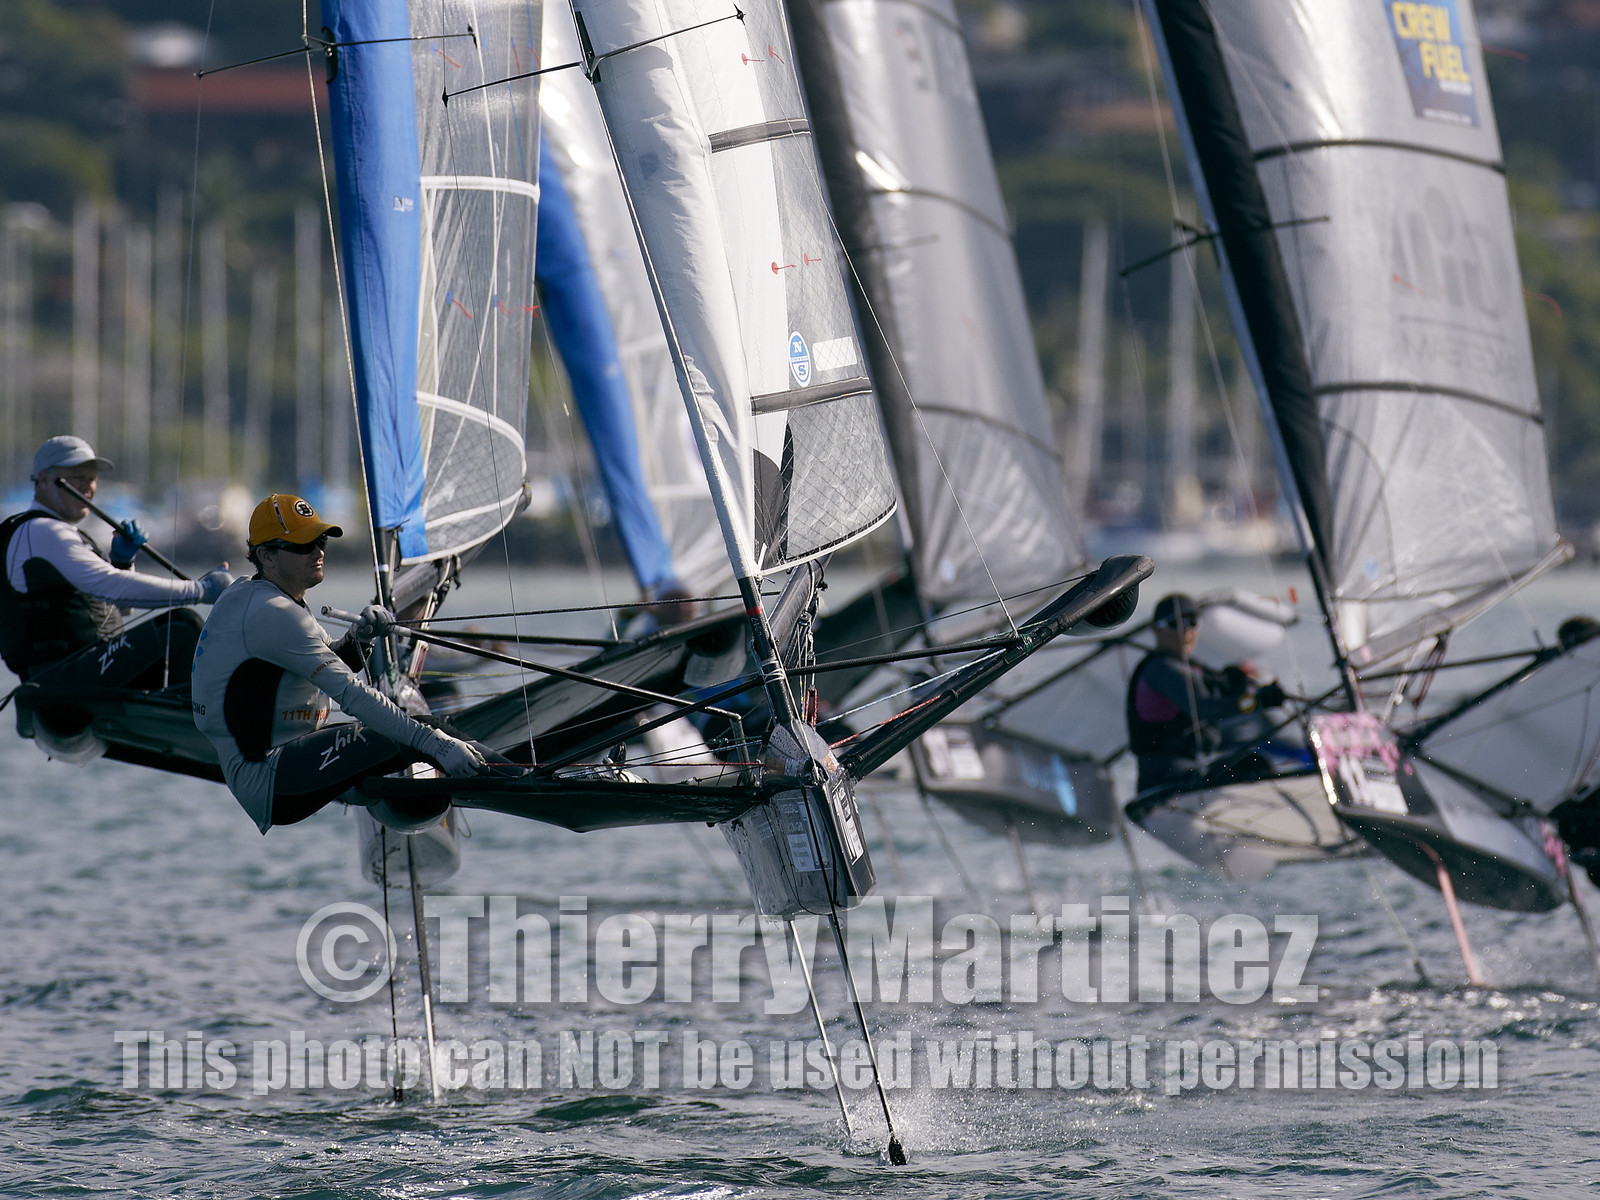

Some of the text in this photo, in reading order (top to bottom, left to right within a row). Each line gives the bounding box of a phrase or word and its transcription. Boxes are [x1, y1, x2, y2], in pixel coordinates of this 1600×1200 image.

[1391, 1, 1451, 42] CREW
[1419, 40, 1471, 83] FUEL
[792, 341, 803, 353] N
[798, 364, 807, 376] S
[282, 710, 312, 721] 11TH
